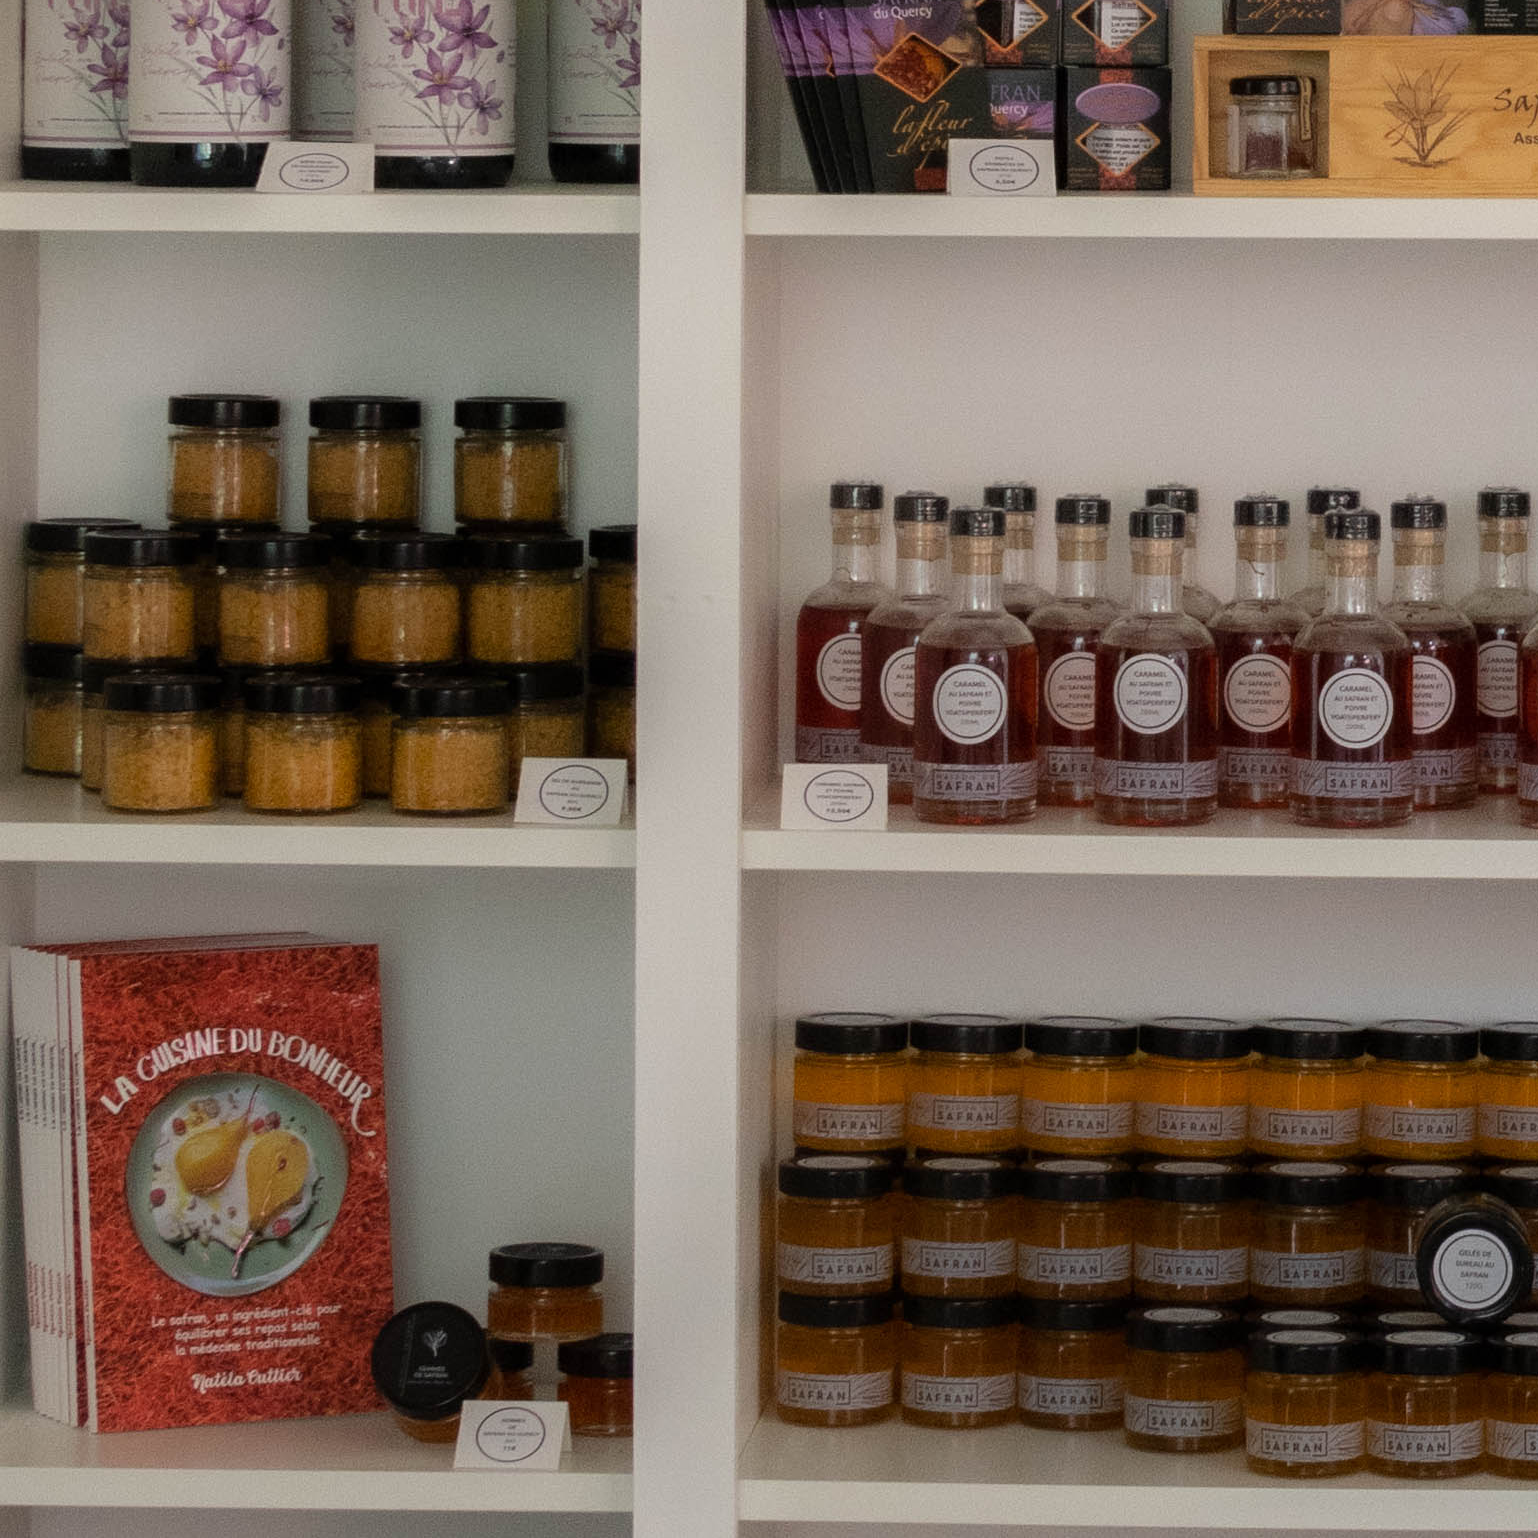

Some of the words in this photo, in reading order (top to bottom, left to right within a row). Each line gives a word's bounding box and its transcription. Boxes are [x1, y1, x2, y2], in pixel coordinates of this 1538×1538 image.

[873, 7, 889, 20] du
[891, 6, 933, 21] Quercy
[991, 85, 1041, 101] FRAN
[1330, 778, 1389, 790] SAFRAN
[100, 1074, 140, 1115] LA
[136, 1027, 229, 1082] CUISINE
[231, 1028, 262, 1054] DU
[266, 1030, 377, 1137] BONHEUR
[923, 1258, 983, 1270] SAFRAN
[151, 1314, 166, 1327] Le
[215, 1312, 229, 1323] un
[316, 1303, 343, 1317] pour
[175, 1326, 229, 1342] équilibrer
[232, 1326, 251, 1337] ses
[255, 1324, 287, 1338] repas
[290, 1320, 321, 1332] selon
[175, 1344, 187, 1356] la
[189, 1341, 241, 1355] médecine
[245, 1334, 321, 1352] traditionnelle
